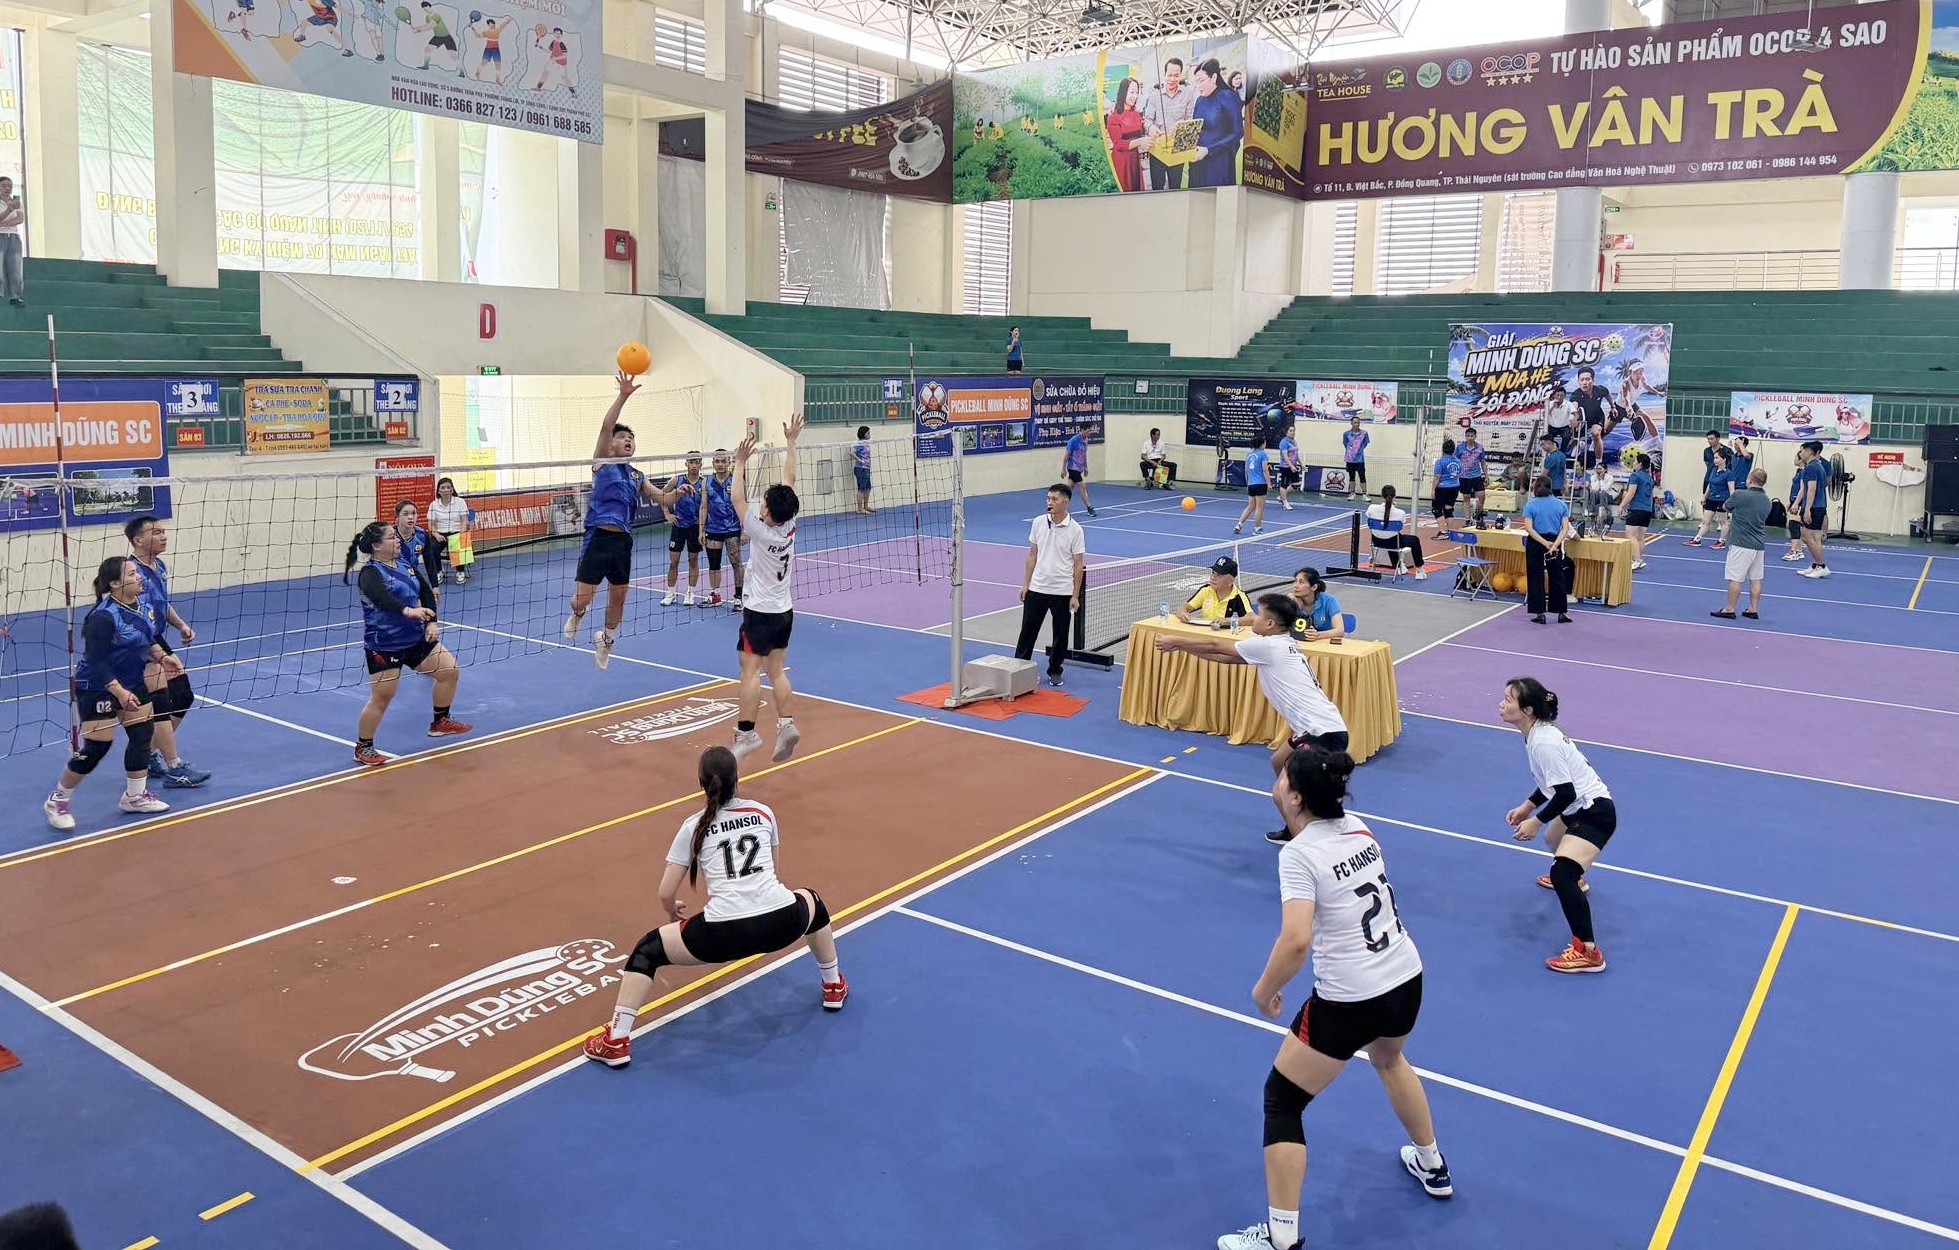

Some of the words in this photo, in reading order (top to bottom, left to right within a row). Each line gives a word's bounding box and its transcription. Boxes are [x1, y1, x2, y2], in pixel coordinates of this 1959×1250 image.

[1550, 49, 1578, 76] TỰ
[1580, 43, 1622, 72] HÀO
[1628, 36, 1672, 68] SẢN
[1677, 28, 1743, 62] PHẨM
[1839, 20, 1886, 47] SAO
[1480, 52, 1540, 74] OCOP
[1317, 88, 1336, 98] TEA
[1338, 84, 1372, 97] HOUSE
[392, 86, 442, 108] HOTLINE:
[446, 97, 472, 113] 0366
[476, 102, 495, 117] 827
[499, 106, 517, 121] 123
[520, 110, 524, 122] /
[526, 111, 550, 126] 0961
[554, 116, 571, 130] 688
[574, 120, 591, 134] 585
[1318, 108, 1528, 166] HƯƠNG
[1547, 86, 1684, 152] VÂN
[1708, 68, 1839, 140] TRÀ
[1702, 162, 1724, 172] 0973
[1727, 160, 1744, 170] 102
[1746, 160, 1762, 169] 061
[1772, 158, 1796, 168] 0986
[1799, 156, 1816, 166] 144
[1819, 154, 1837, 165] 954
[1334, 184, 1345, 193] 11,
[1388, 181, 1394, 189] P.
[1416, 177, 1441, 188] Quang,
[1443, 176, 1453, 186] TP.
[1455, 175, 1471, 184] Thái
[1473, 174, 1502, 186] Nguyên
[1548, 170, 1563, 179] Cao
[1624, 164, 1646, 177] Nghệ
[479, 303, 496, 338] D
[1487, 330, 1515, 349] GIẢI
[1466, 347, 1519, 376] MINH
[1519, 340, 1570, 373] DŨNG
[1572, 338, 1600, 364] SC
[187, 392, 197, 408] 3
[393, 390, 401, 405] 2
[1046, 384, 1058, 397] SỬA
[1216, 386, 1241, 395] Duong
[1243, 386, 1263, 396] Long
[950, 399, 986, 413] PICKLEBALL
[988, 398, 1003, 411] MINH
[1021, 397, 1028, 410] SC
[1472, 394, 1506, 416] SÔI
[0, 422, 56, 449] MINH
[62, 416, 119, 446] DŨNG
[125, 419, 152, 444] SC
[475, 508, 520, 530] PICKLEBALL
[520, 506, 541, 525] MINH
[1295, 618, 1306, 632] 9
[705, 824, 718, 837] FC
[721, 815, 763, 832] HANSOL
[716, 833, 764, 880] 12
[1333, 861, 1350, 881] FC
[362, 1008, 476, 1062] Minh
[464, 970, 582, 1018] Dũng
[567, 946, 628, 976] SC
[457, 968, 628, 1047] PICKLEBA
